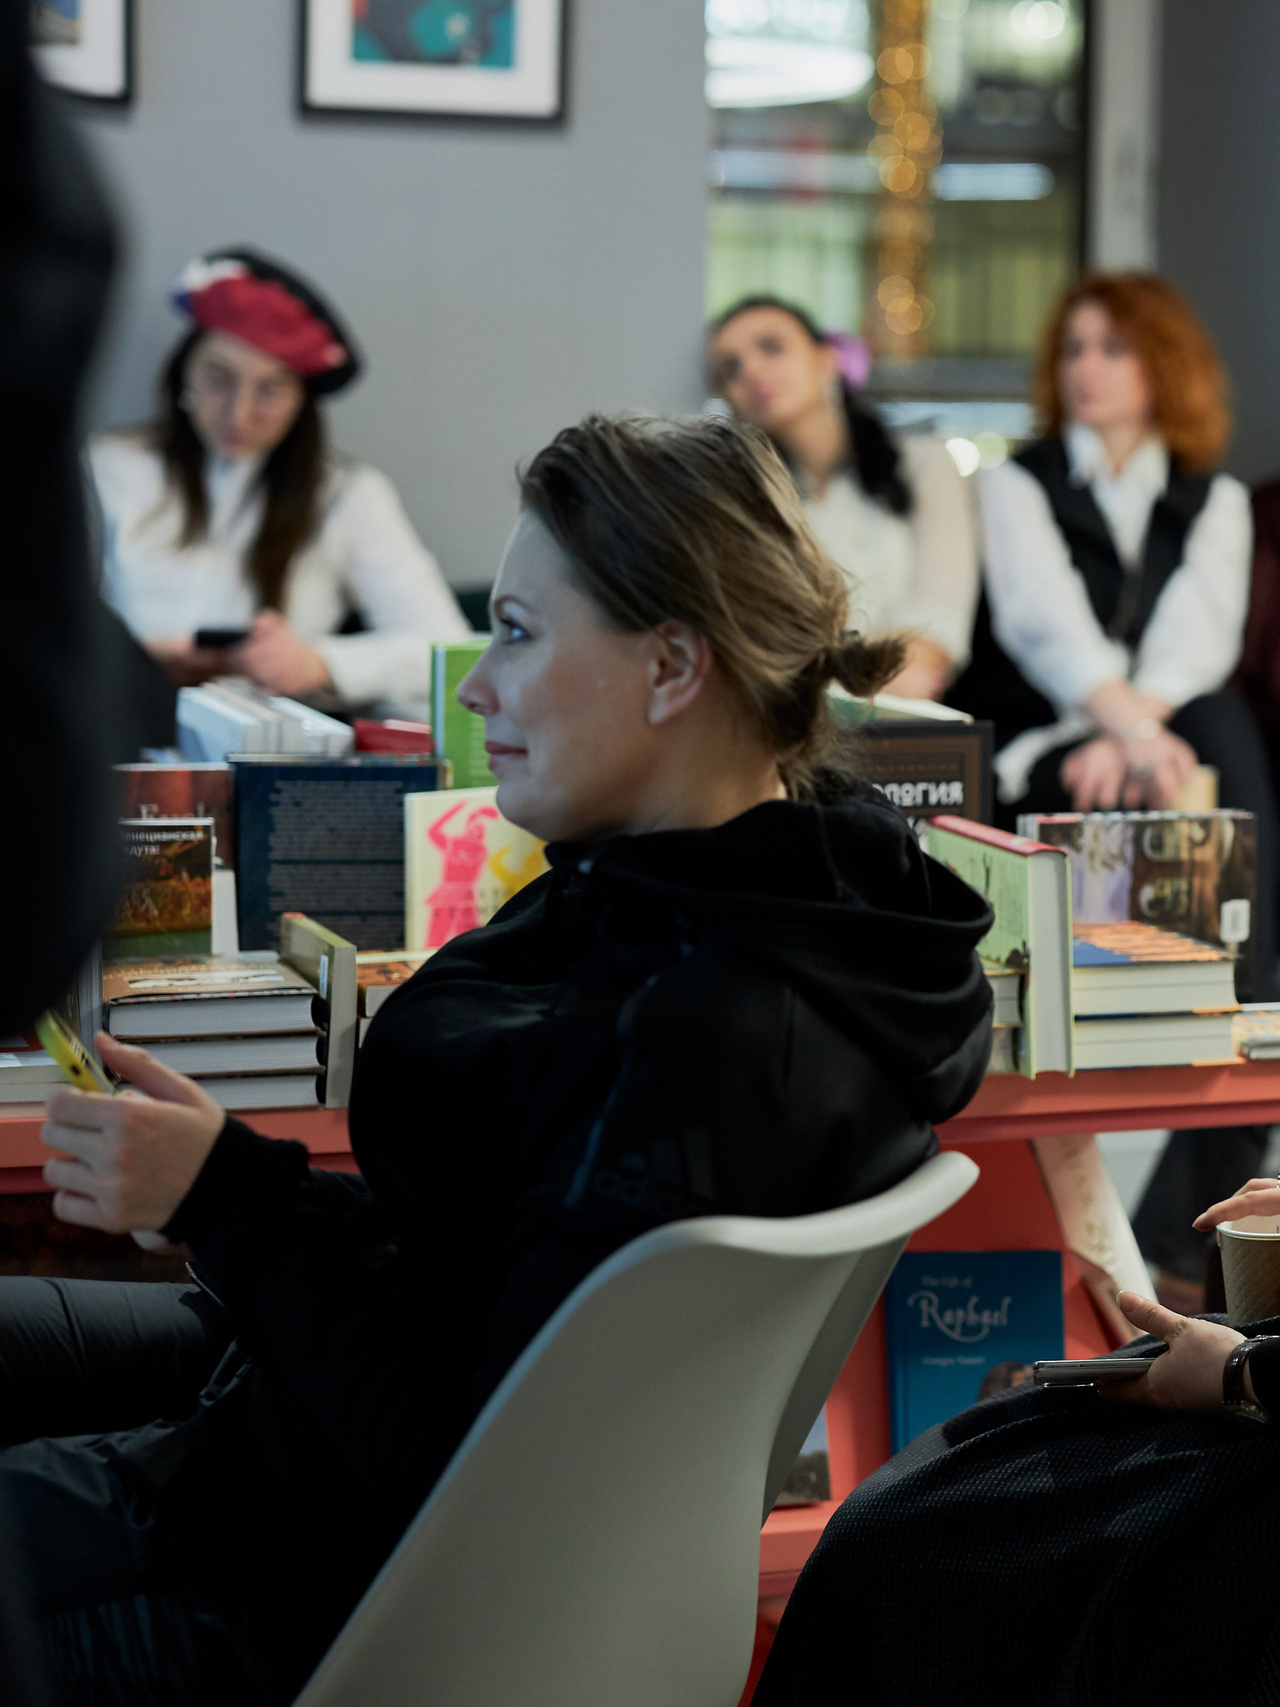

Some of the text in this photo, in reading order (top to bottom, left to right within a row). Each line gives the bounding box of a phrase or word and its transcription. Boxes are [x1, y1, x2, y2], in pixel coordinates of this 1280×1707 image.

[873, 781, 964, 807] логия
[121, 830, 203, 843] енецианская
[907, 1290, 1012, 1342] Raphael
